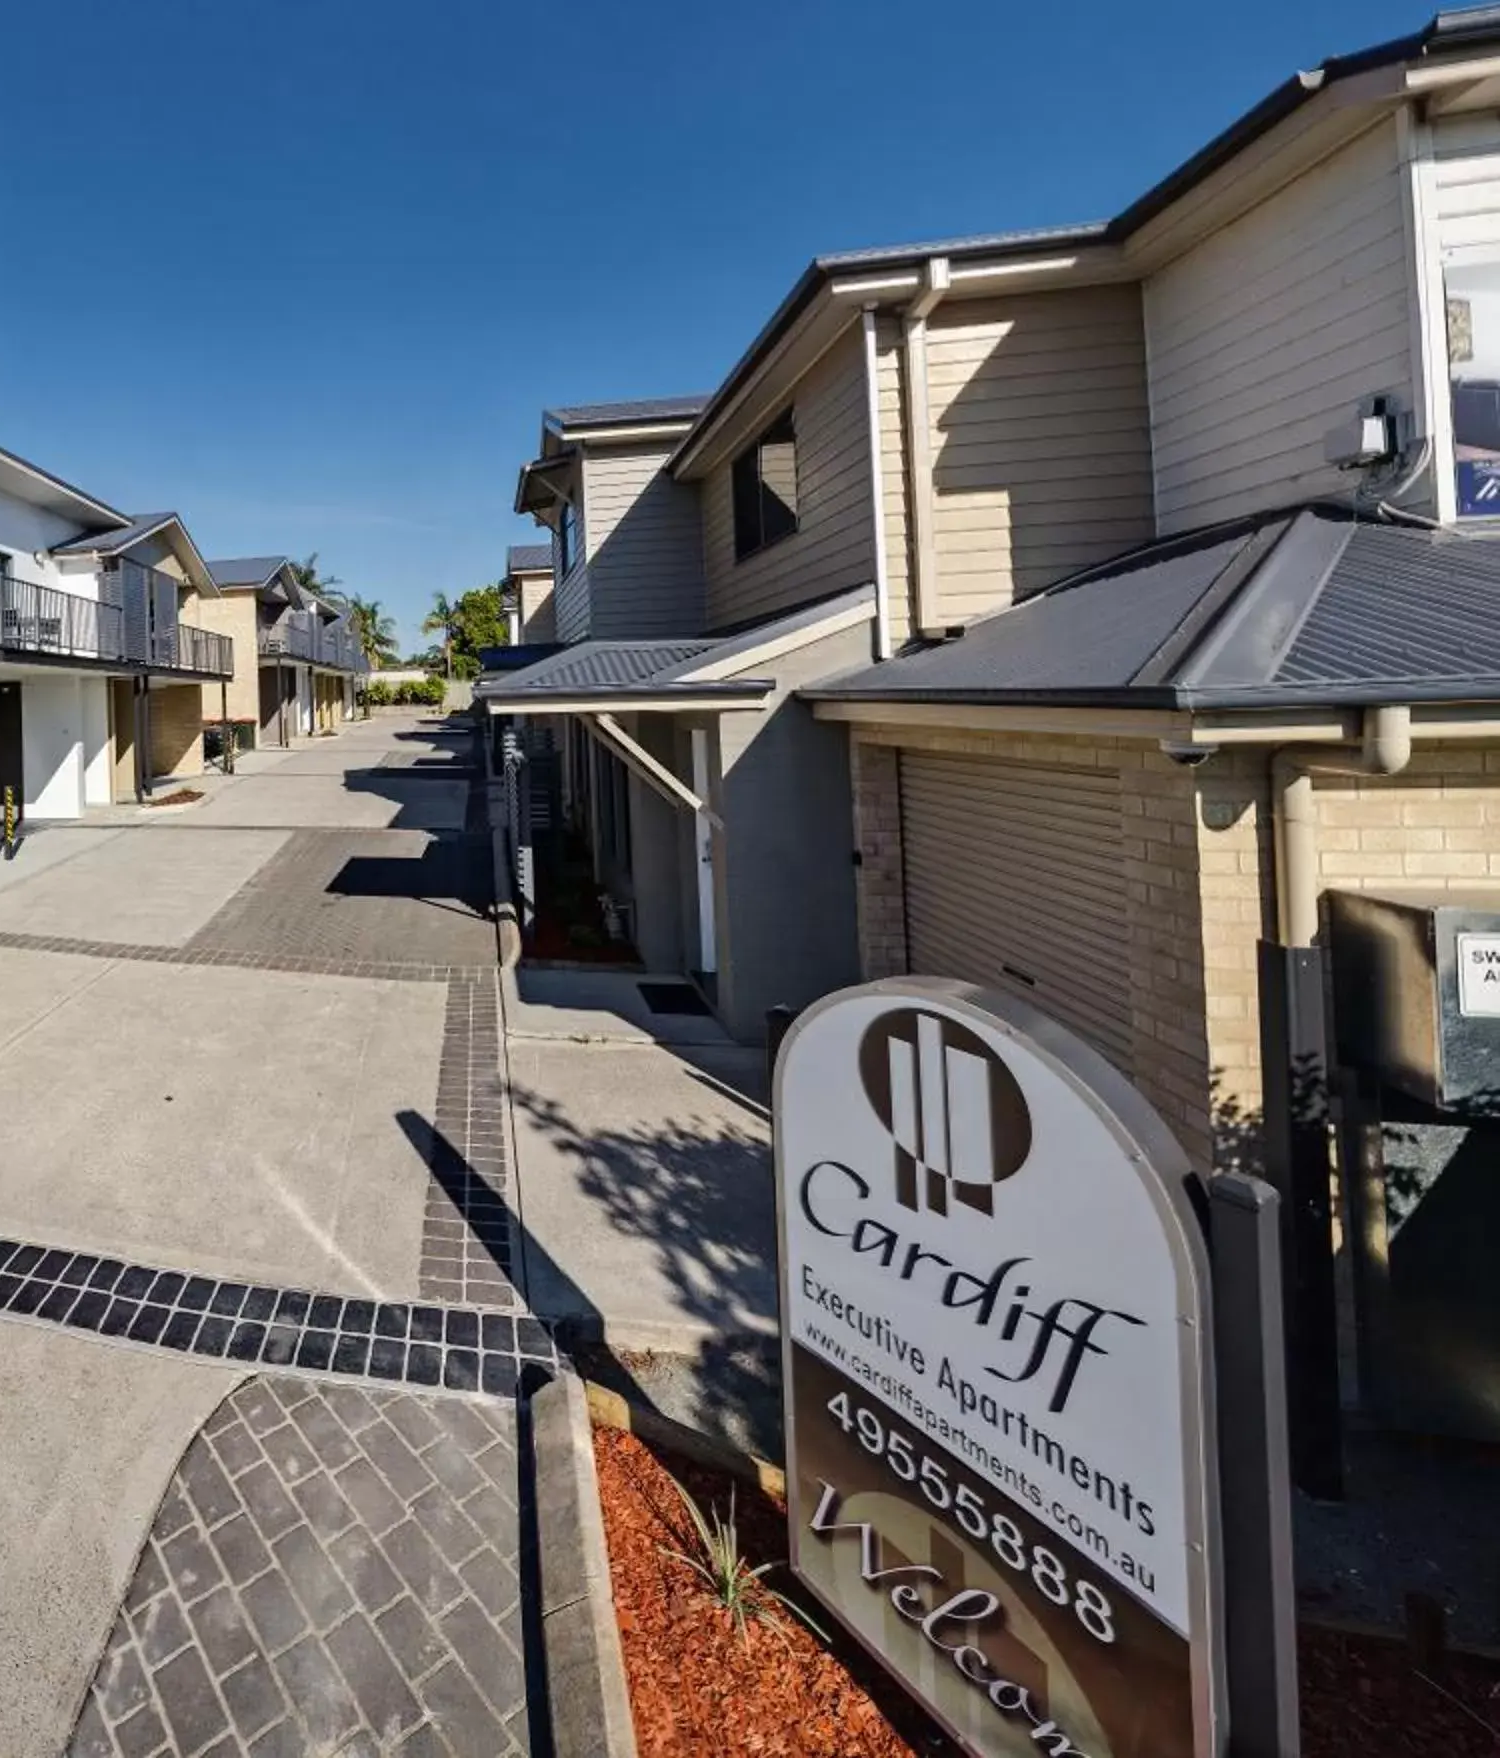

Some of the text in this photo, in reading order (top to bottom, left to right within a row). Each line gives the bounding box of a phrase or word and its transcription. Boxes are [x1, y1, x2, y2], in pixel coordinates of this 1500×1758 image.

[800, 1161, 1148, 1412] Cardiff
[802, 1264, 1155, 1536] Executive Apartments
[805, 1321, 1155, 1593] www.cardiffapartments.com.au
[827, 1391, 1115, 1643] 49555888
